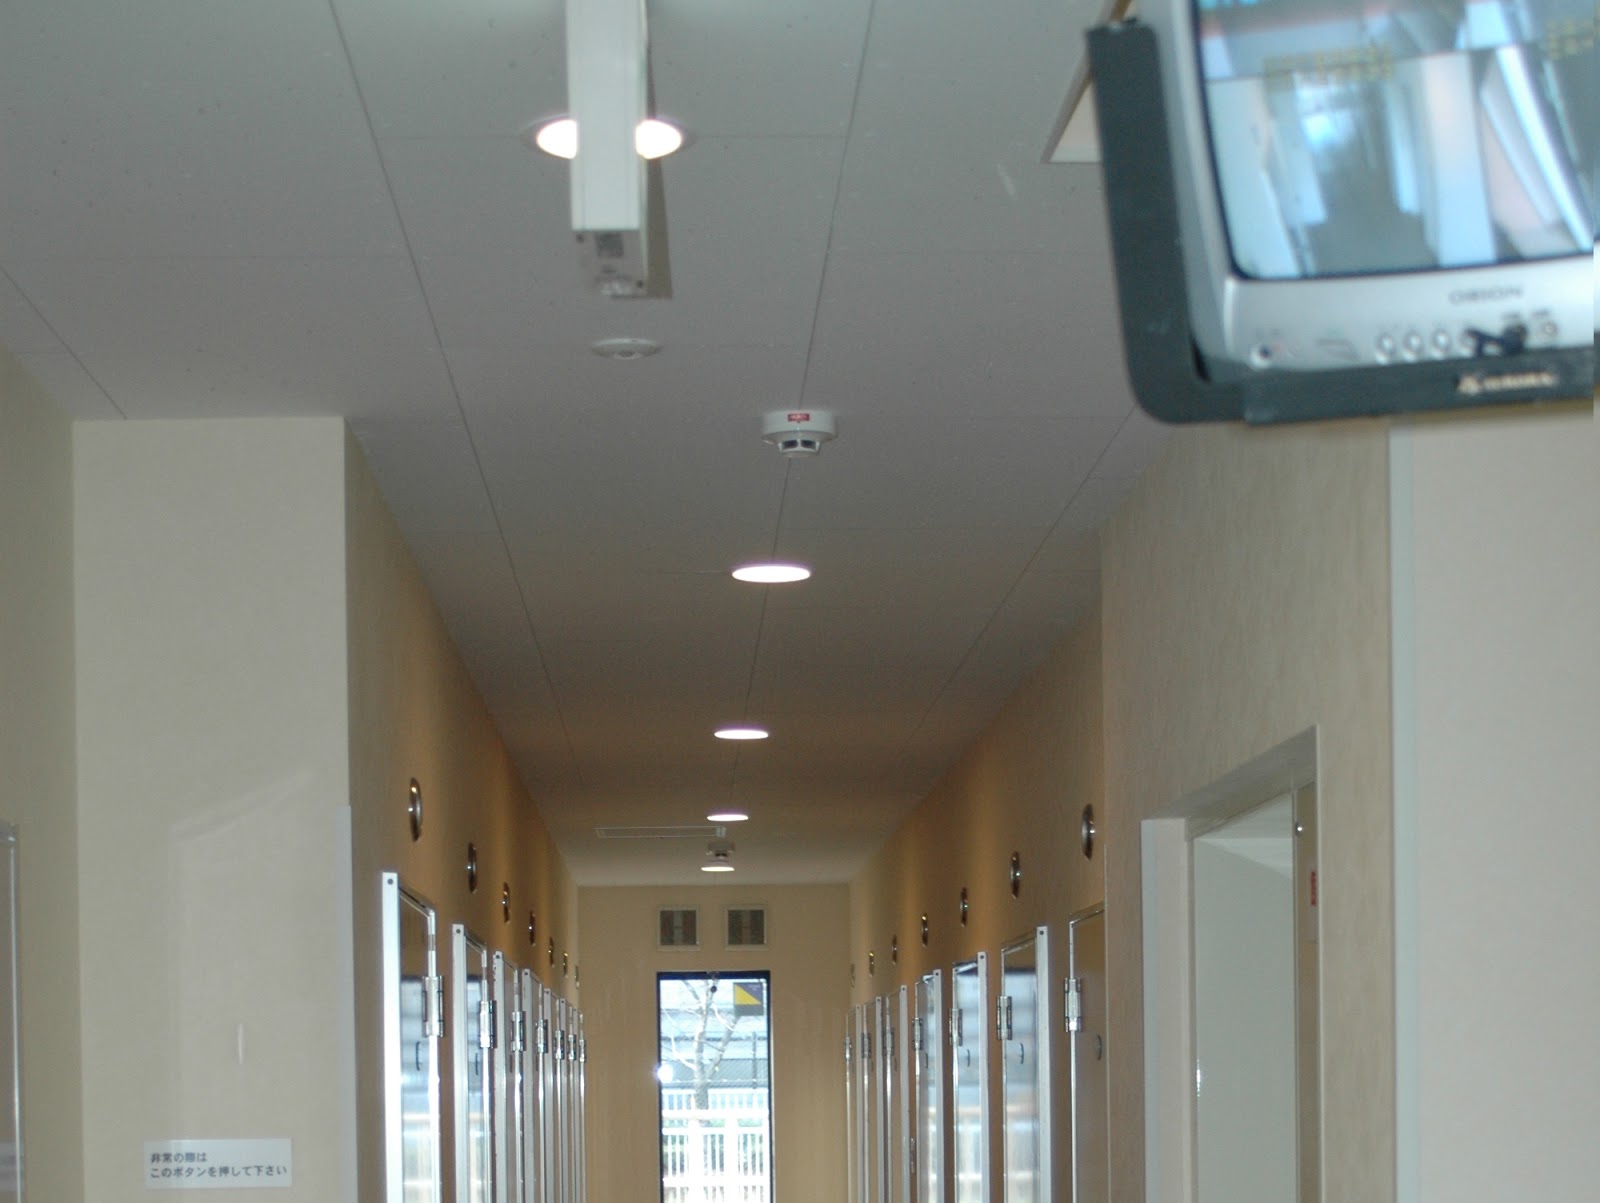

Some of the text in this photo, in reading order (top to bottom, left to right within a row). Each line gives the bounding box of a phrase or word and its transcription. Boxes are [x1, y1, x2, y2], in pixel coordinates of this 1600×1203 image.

[150, 1165, 287, 1178] このボタンを押して下さい
